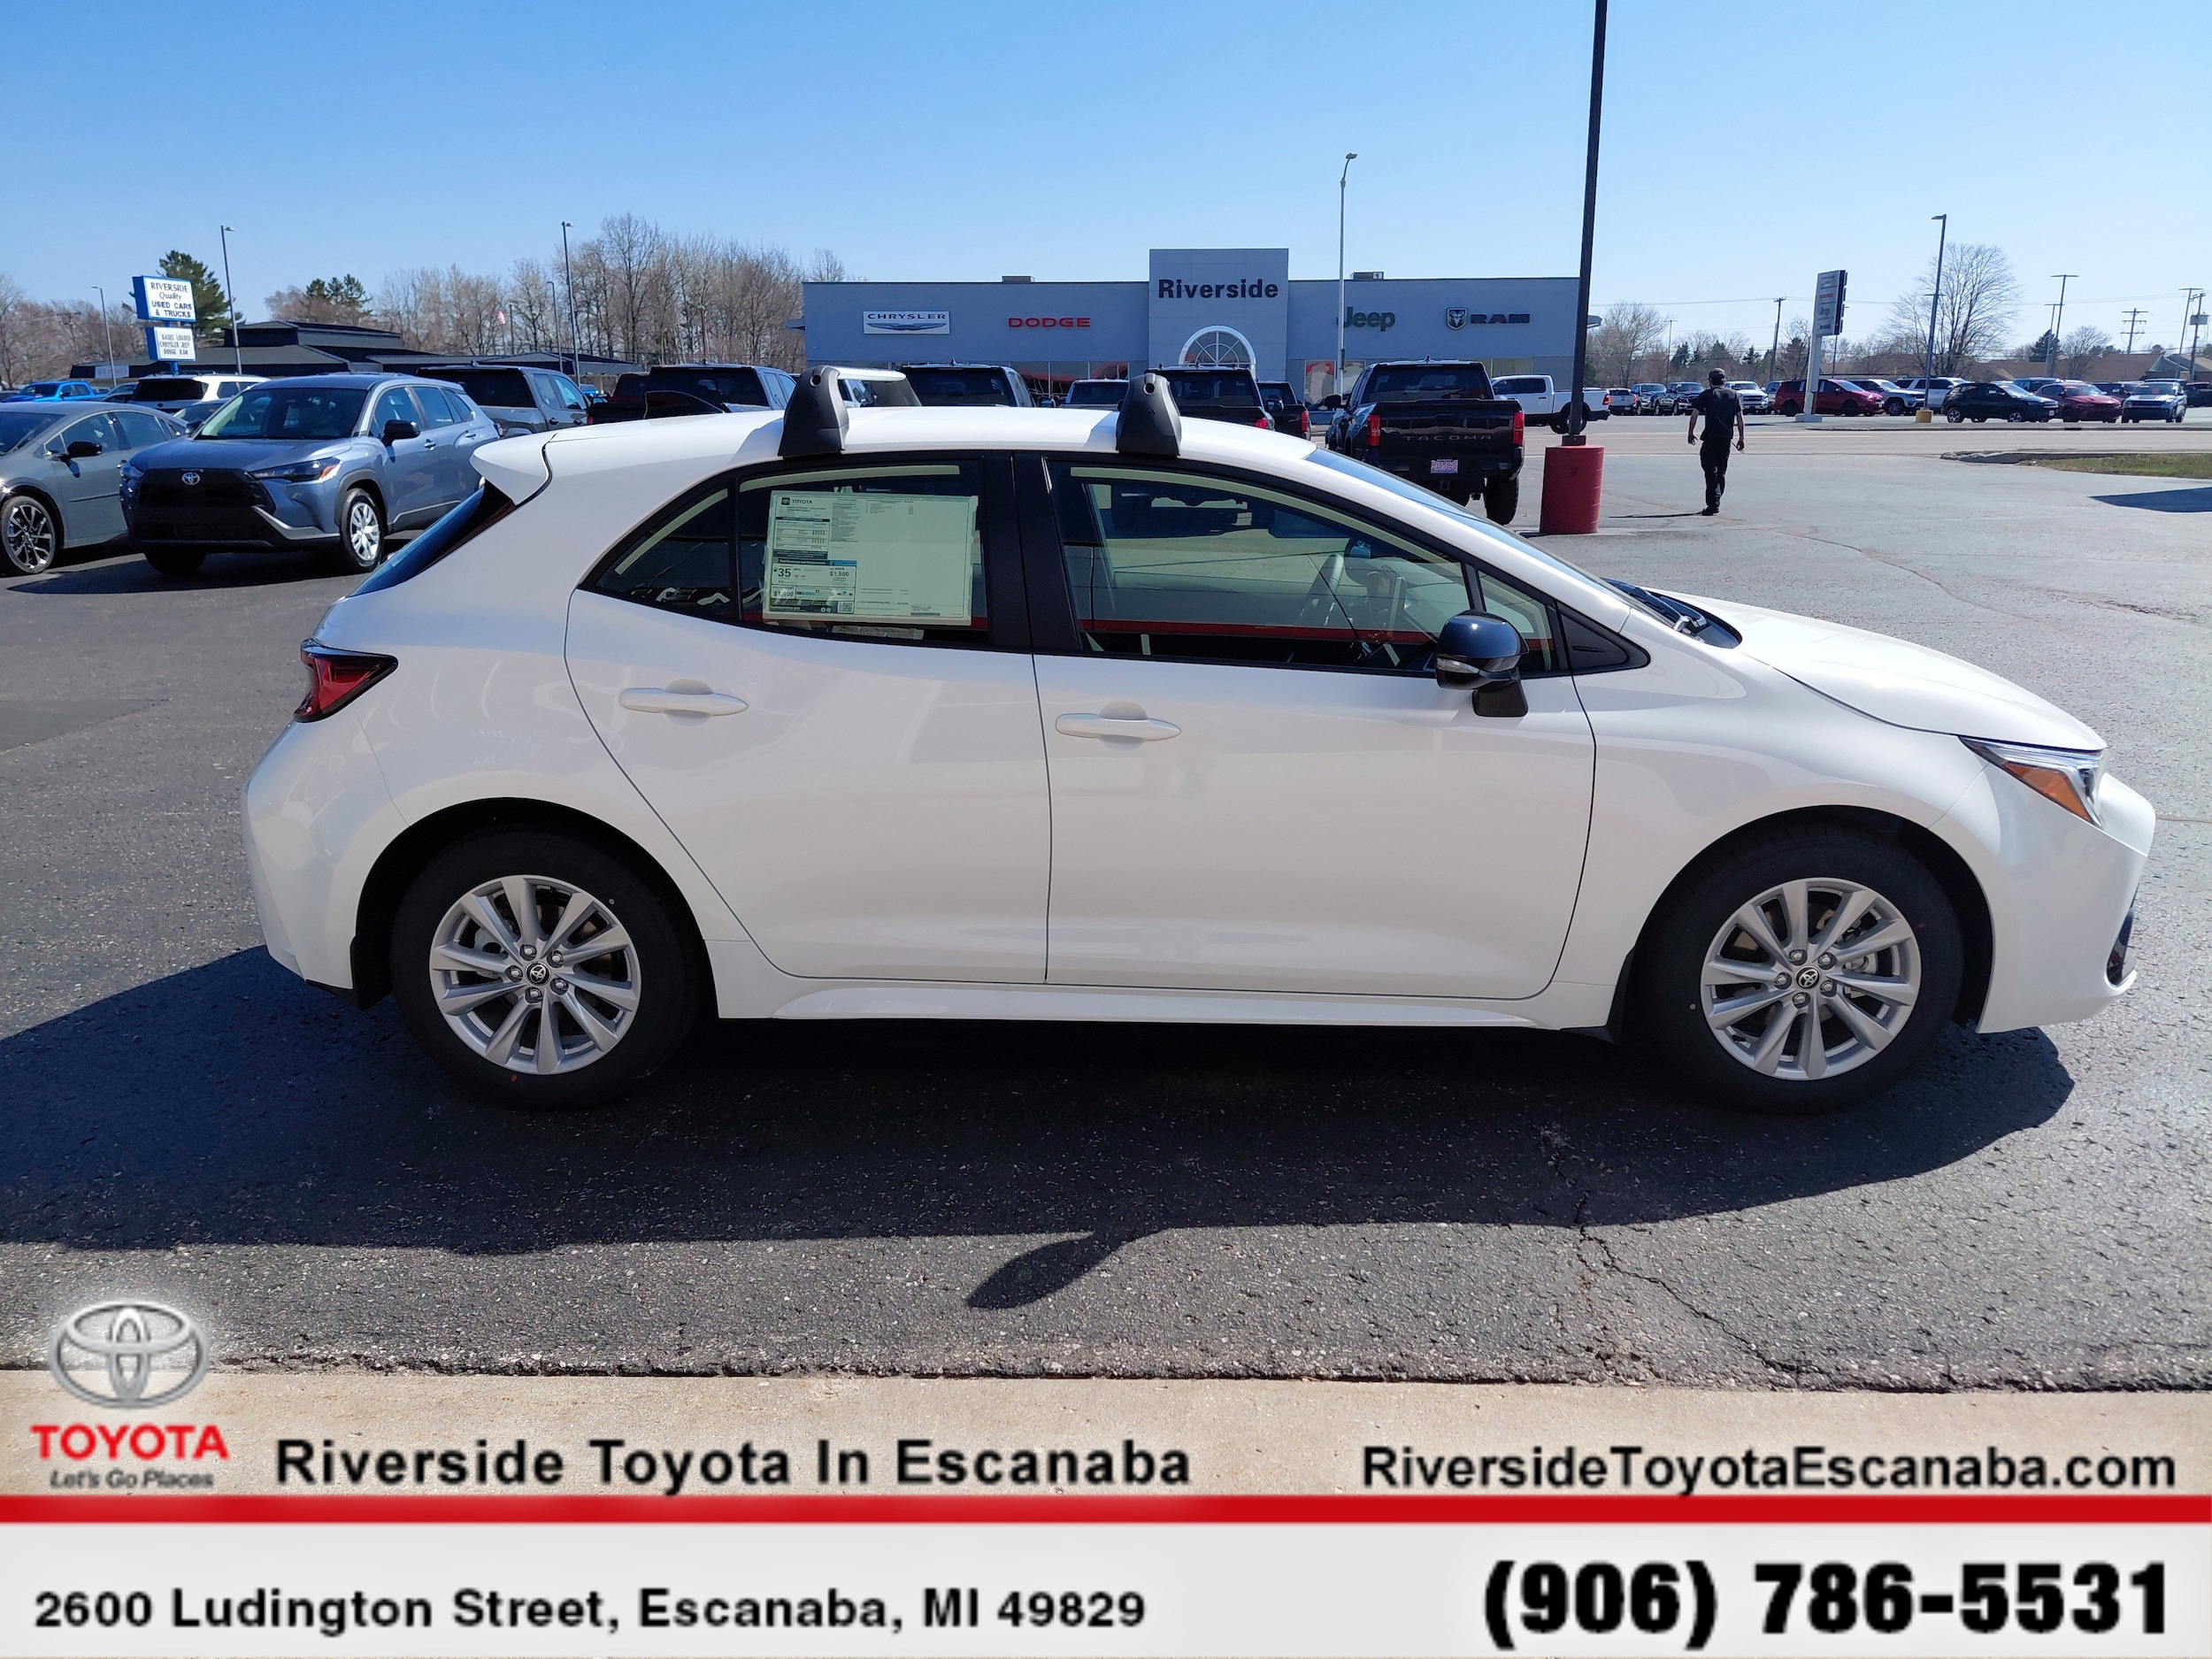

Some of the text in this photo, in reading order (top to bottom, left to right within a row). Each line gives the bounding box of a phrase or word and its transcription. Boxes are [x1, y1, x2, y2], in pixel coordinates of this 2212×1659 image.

[150, 282, 188, 293] RIVERSIDE
[1158, 279, 1279, 298] Riverside
[159, 292, 182, 302] Quality
[164, 310, 191, 319] TRUCKS
[1336, 306, 1396, 331] Jeep
[1471, 313, 1531, 324] RAM
[1008, 317, 1090, 327] DODGE
[778, 567, 791, 578] 35
